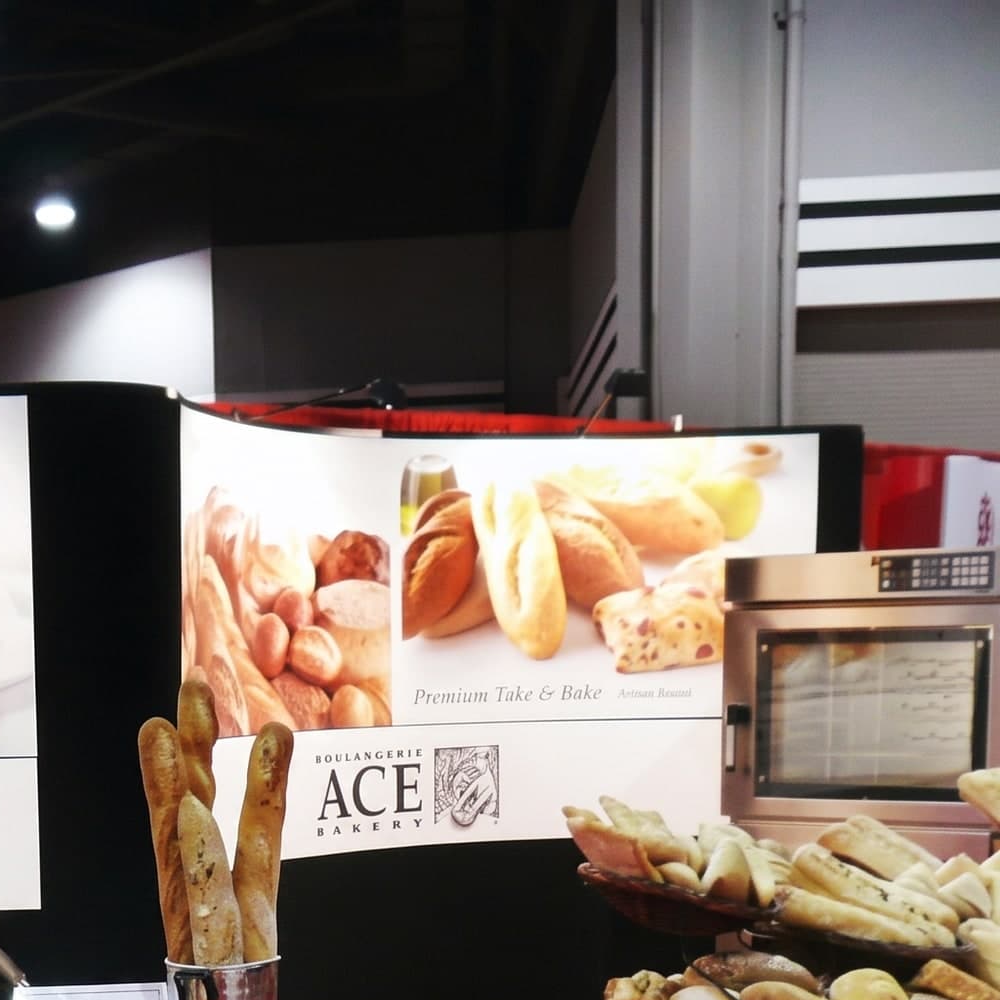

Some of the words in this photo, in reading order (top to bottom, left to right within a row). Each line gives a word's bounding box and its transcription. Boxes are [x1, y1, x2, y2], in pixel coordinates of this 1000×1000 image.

[414, 688, 488, 704] Premium
[496, 686, 533, 702] Take
[539, 685, 555, 701] &
[561, 684, 602, 700] Bake
[316, 748, 422, 764] BOULANGERIE
[317, 763, 423, 820] ACE
[317, 818, 423, 837] BAKERY
